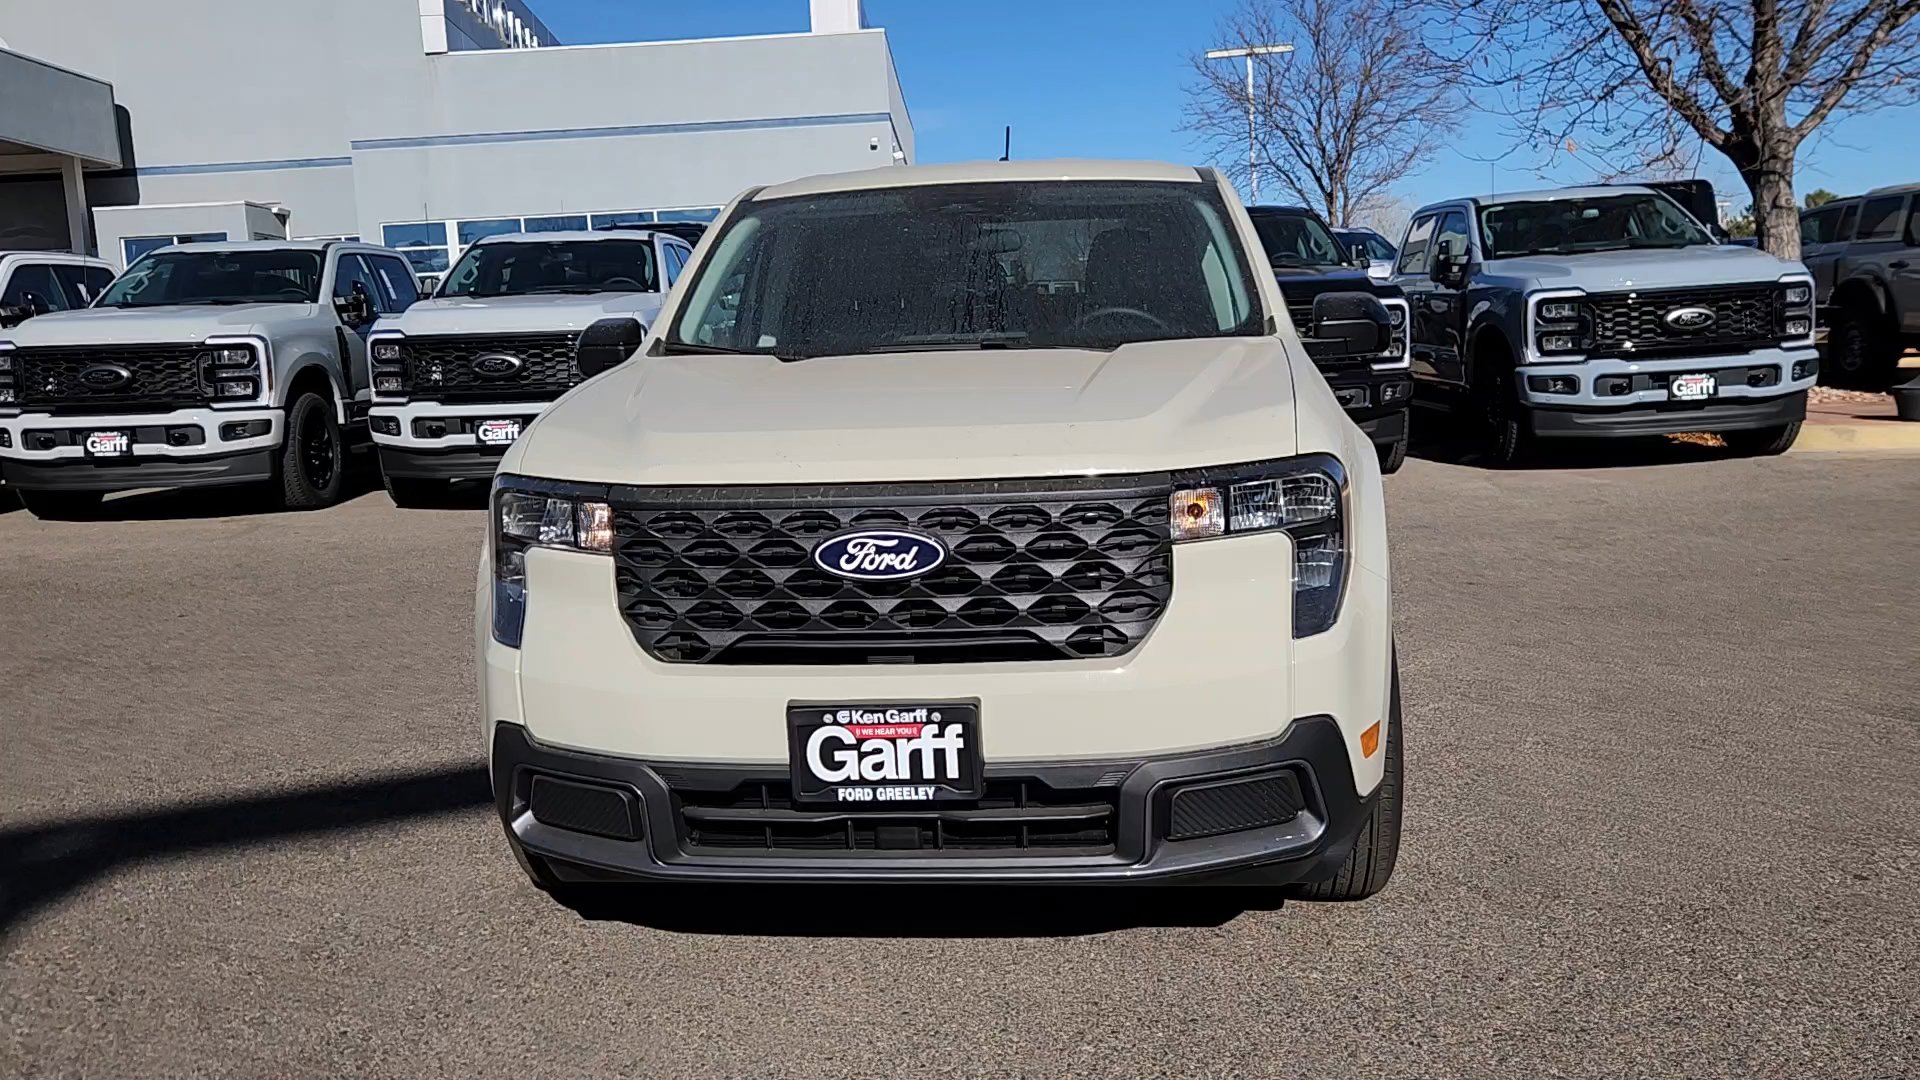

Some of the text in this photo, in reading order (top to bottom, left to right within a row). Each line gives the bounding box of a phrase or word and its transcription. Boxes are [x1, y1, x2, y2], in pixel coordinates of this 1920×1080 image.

[1672, 377, 1715, 397] Garff
[478, 423, 520, 441] Garff
[86, 435, 128, 453] Garff
[839, 538, 919, 571] Ford
[851, 708, 928, 724] Ken Garff
[874, 727, 896, 735] HEAR
[895, 727, 912, 735] YOU
[806, 724, 964, 783] Garff
[838, 786, 936, 802] FORD GREELEY
